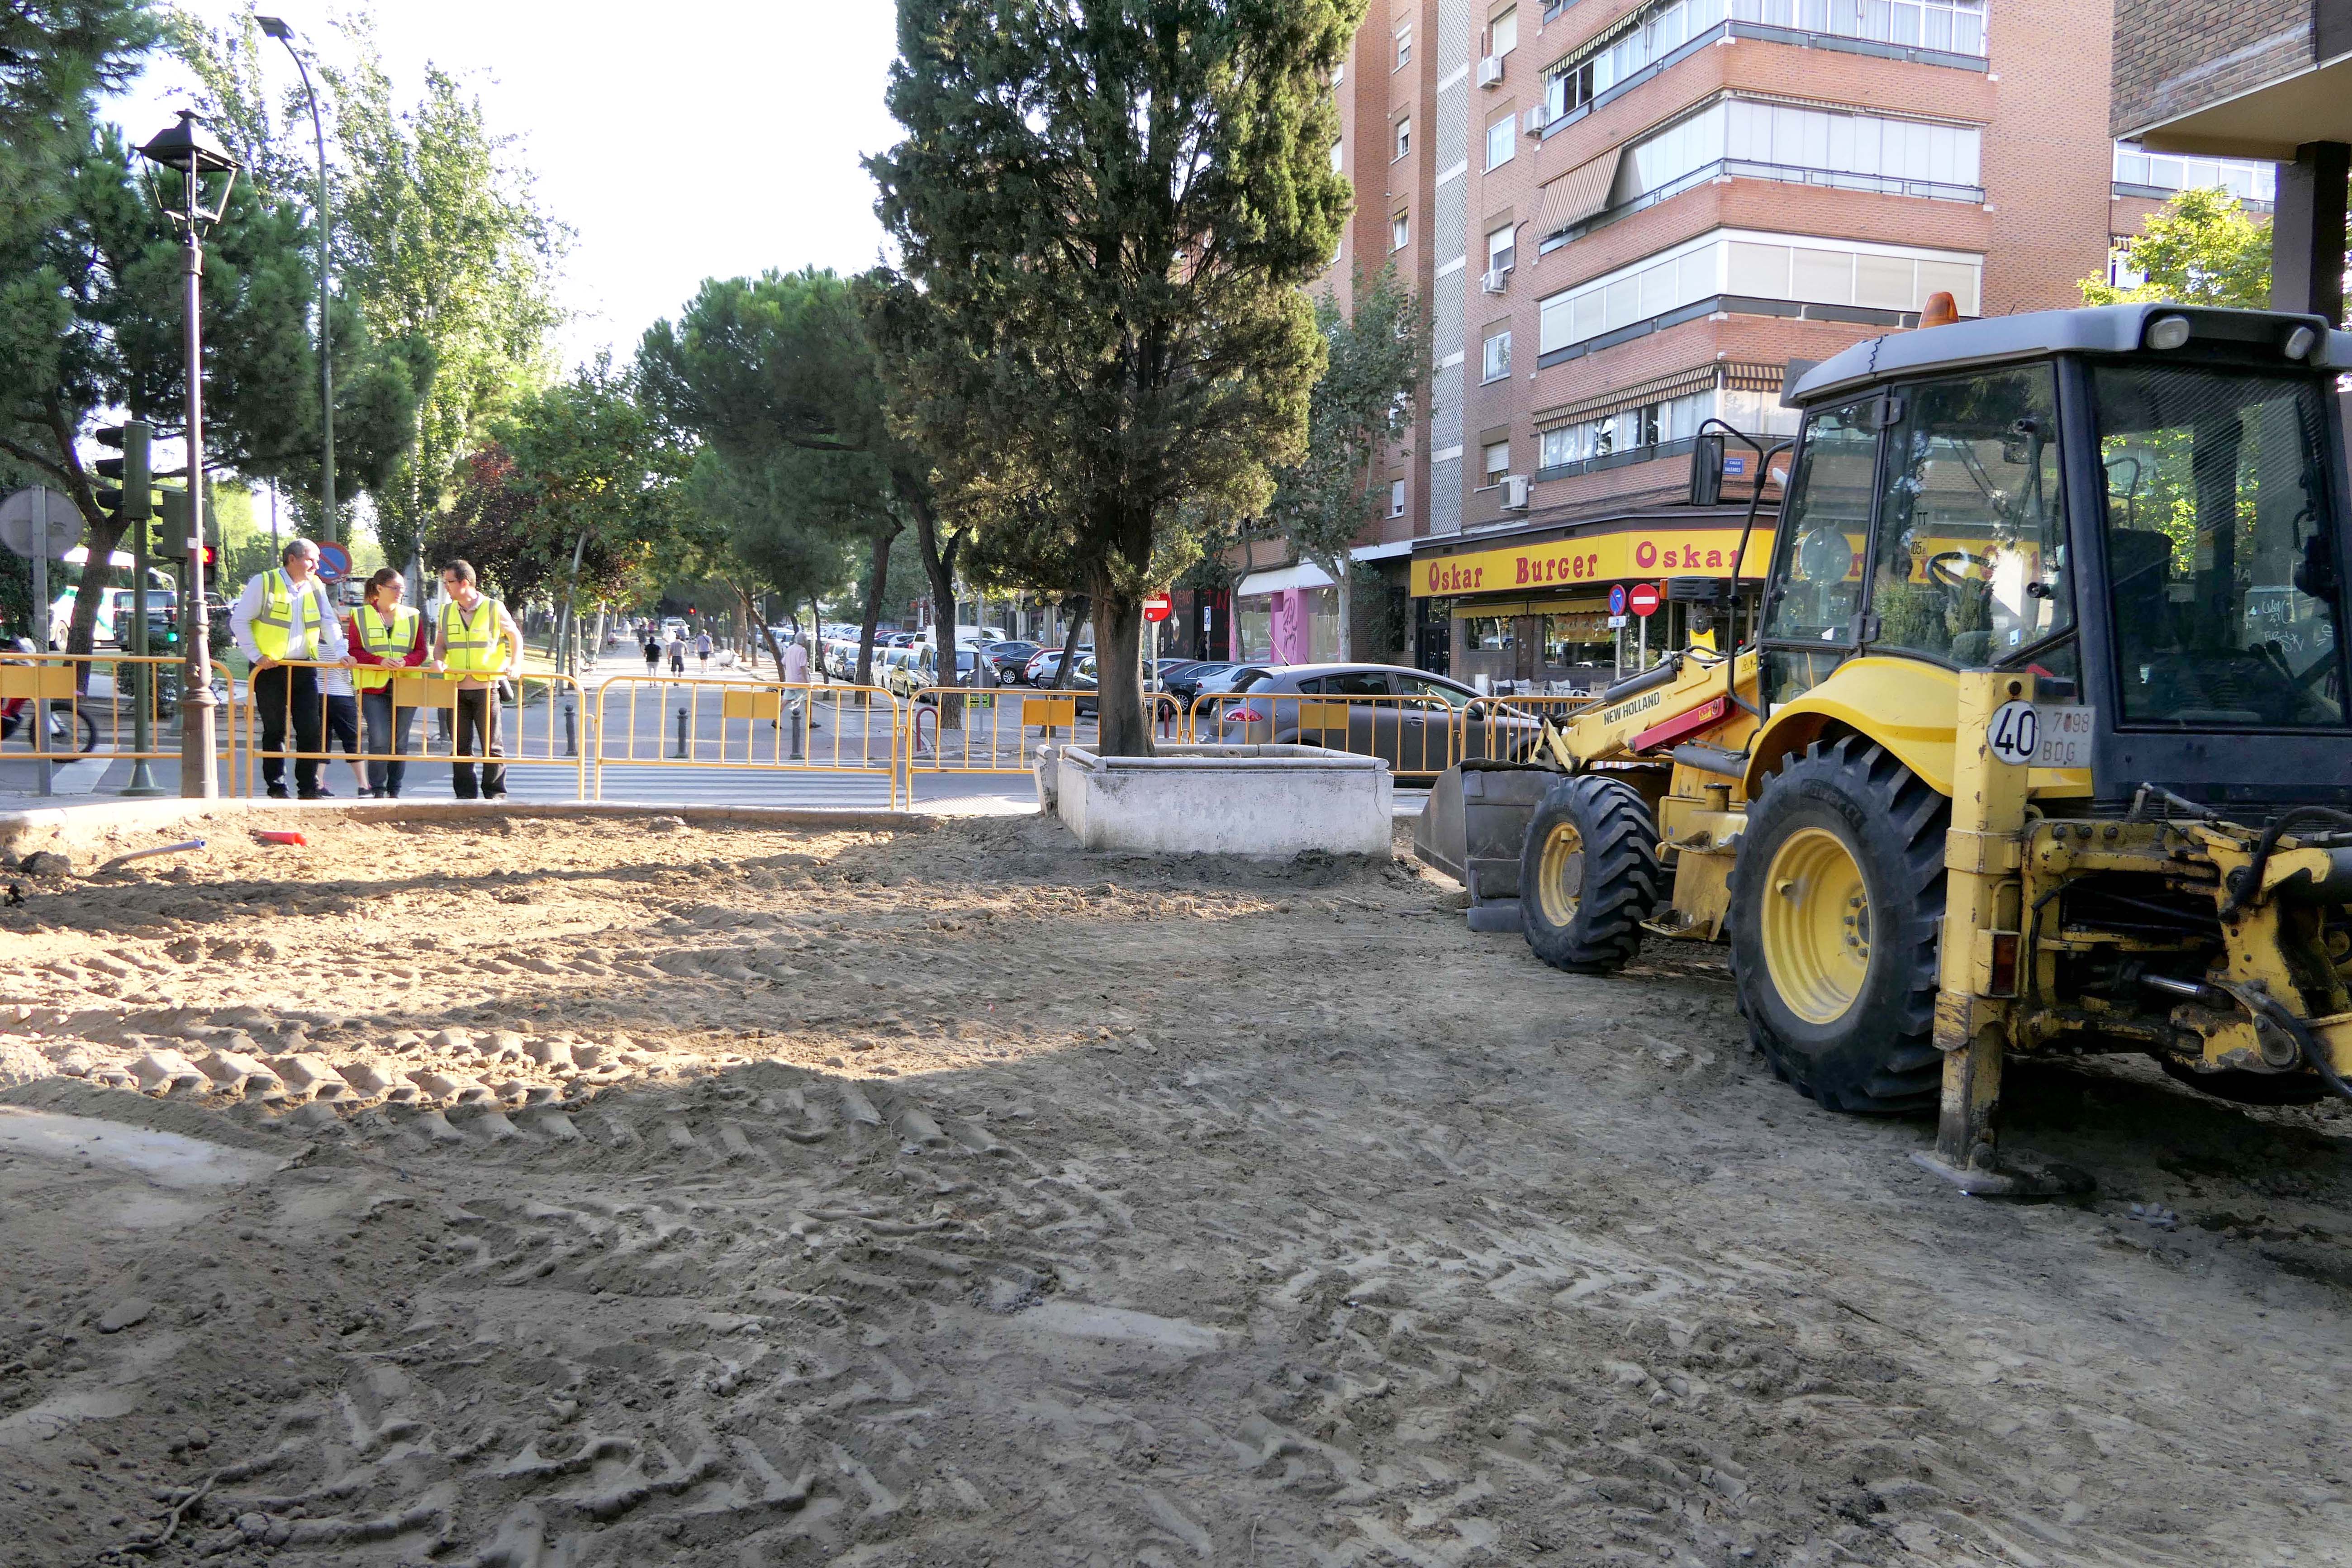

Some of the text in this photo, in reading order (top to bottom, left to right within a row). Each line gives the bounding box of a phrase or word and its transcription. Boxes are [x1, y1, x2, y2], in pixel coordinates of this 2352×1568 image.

[1636, 541, 1739, 568] Oskar
[1429, 554, 1597, 592] Oskar Burger
[1604, 692, 1660, 726] NEW HOLLAND
[1994, 708, 2036, 756] 40
[2043, 741, 2076, 761] BDG
